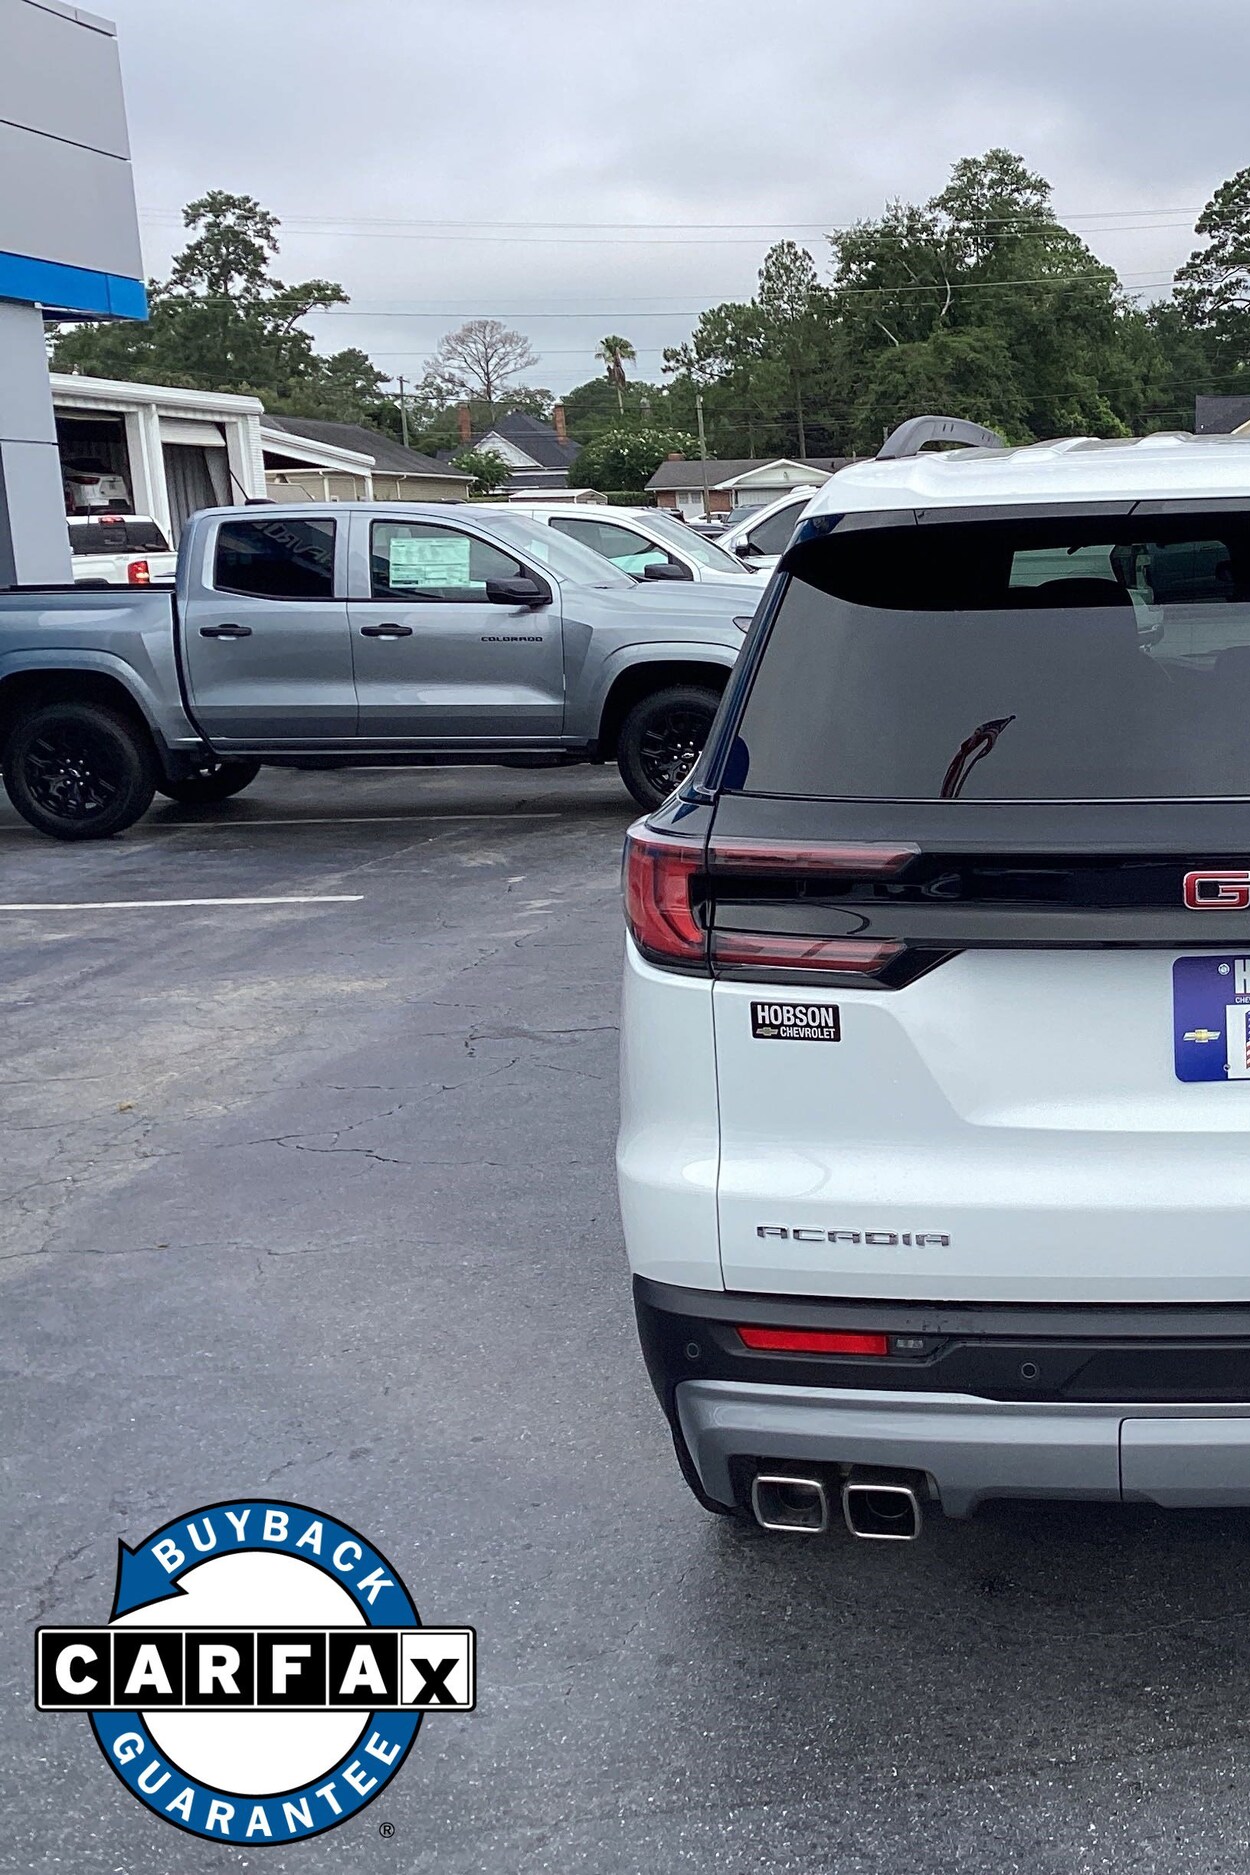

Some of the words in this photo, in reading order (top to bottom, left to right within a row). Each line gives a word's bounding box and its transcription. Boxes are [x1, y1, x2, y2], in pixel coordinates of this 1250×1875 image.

[756, 1004, 834, 1027] HOBSON
[780, 1026, 836, 1039] CHEVROLET
[756, 1223, 951, 1247] ACADIA
